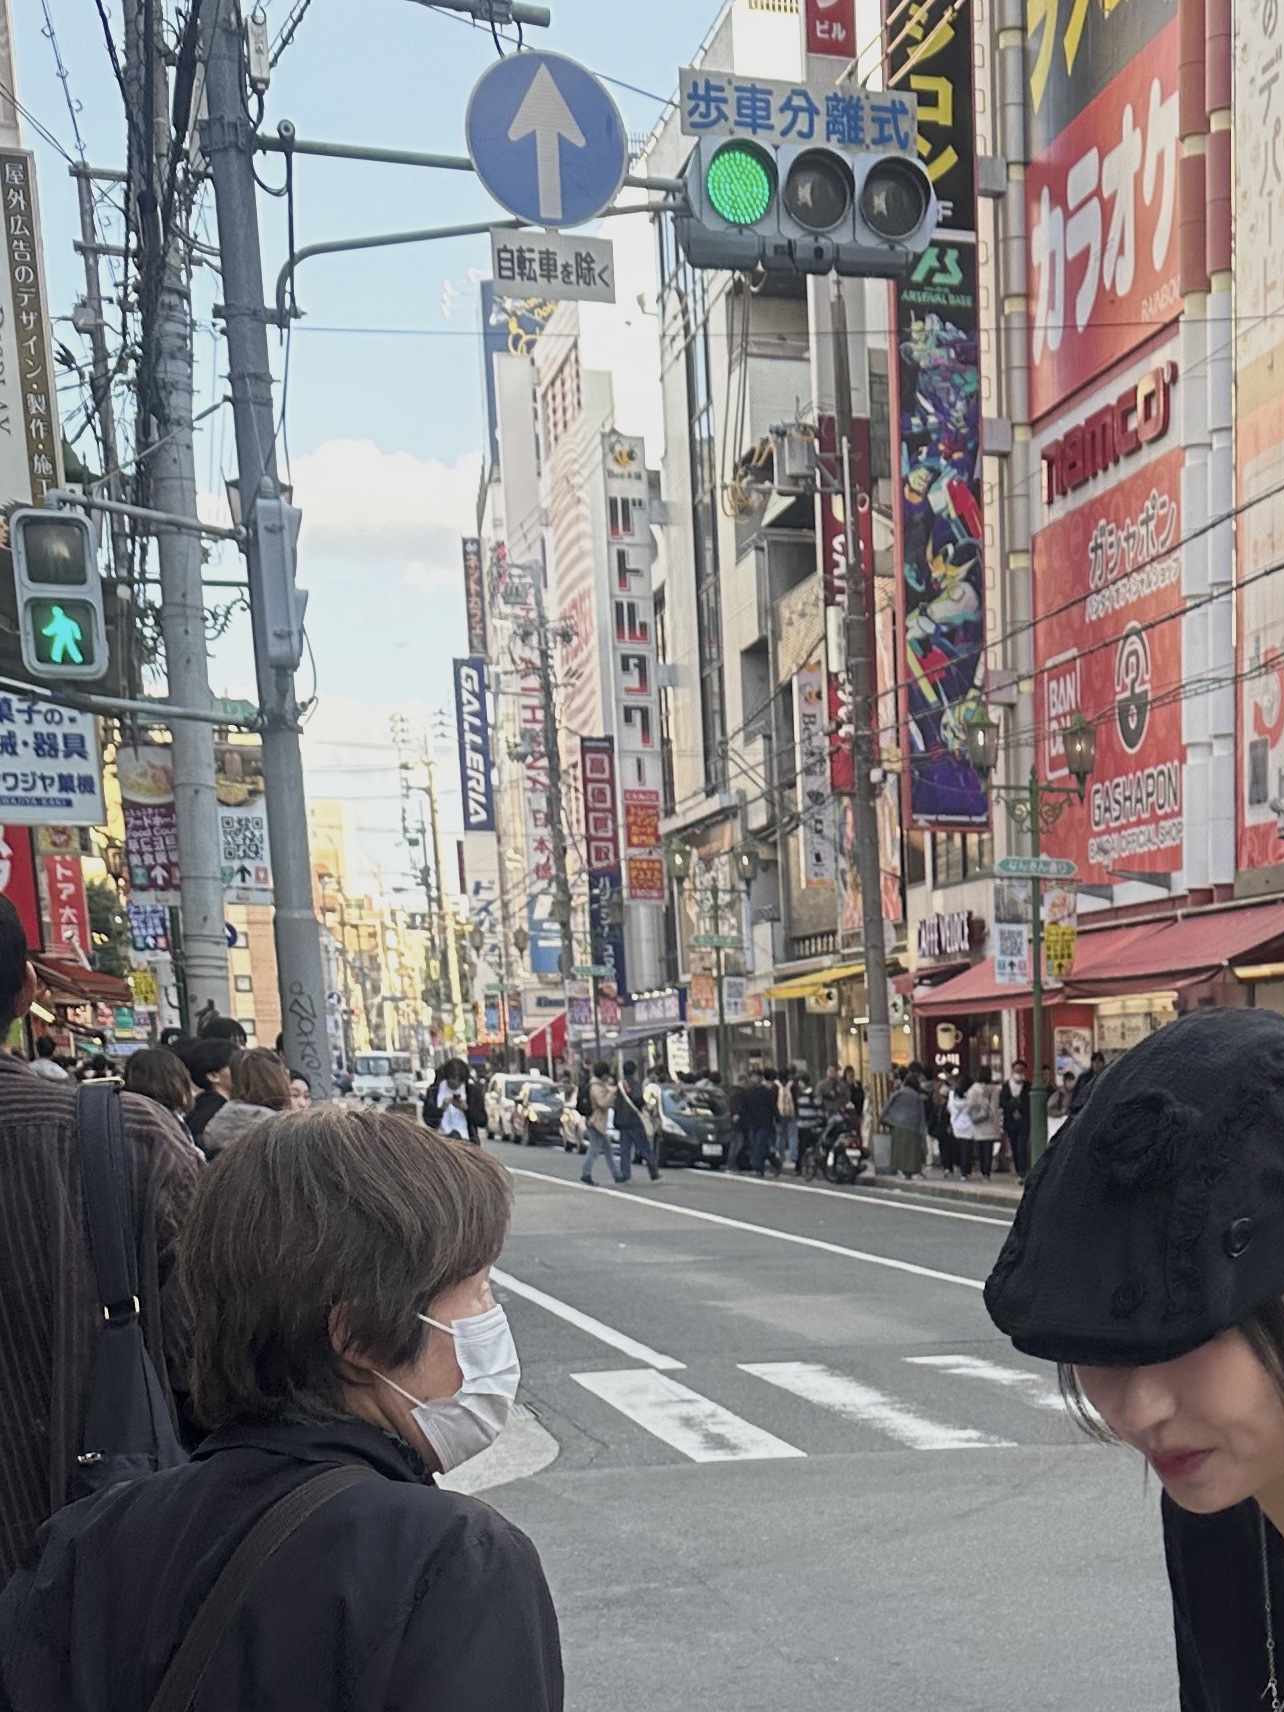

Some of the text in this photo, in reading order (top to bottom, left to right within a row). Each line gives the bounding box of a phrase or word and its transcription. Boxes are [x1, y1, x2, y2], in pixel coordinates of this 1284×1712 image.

[815, 20, 847, 41] ビル
[686, 77, 910, 151] 歩車分離式
[1031, 76, 1180, 364] カラオケ
[496, 244, 610, 288] 自転車を除く
[3, 161, 54, 498] 屋外広告のデザイン・製作・施工
[1041, 366, 1172, 505] namco
[1088, 487, 1177, 590] ガシャポン
[1049, 671, 1076, 717] BAN
[459, 665, 488, 825] GALLERIA
[0, 771, 96, 794] ワジヤ菓機
[1090, 758, 1180, 832] GASHAPON
